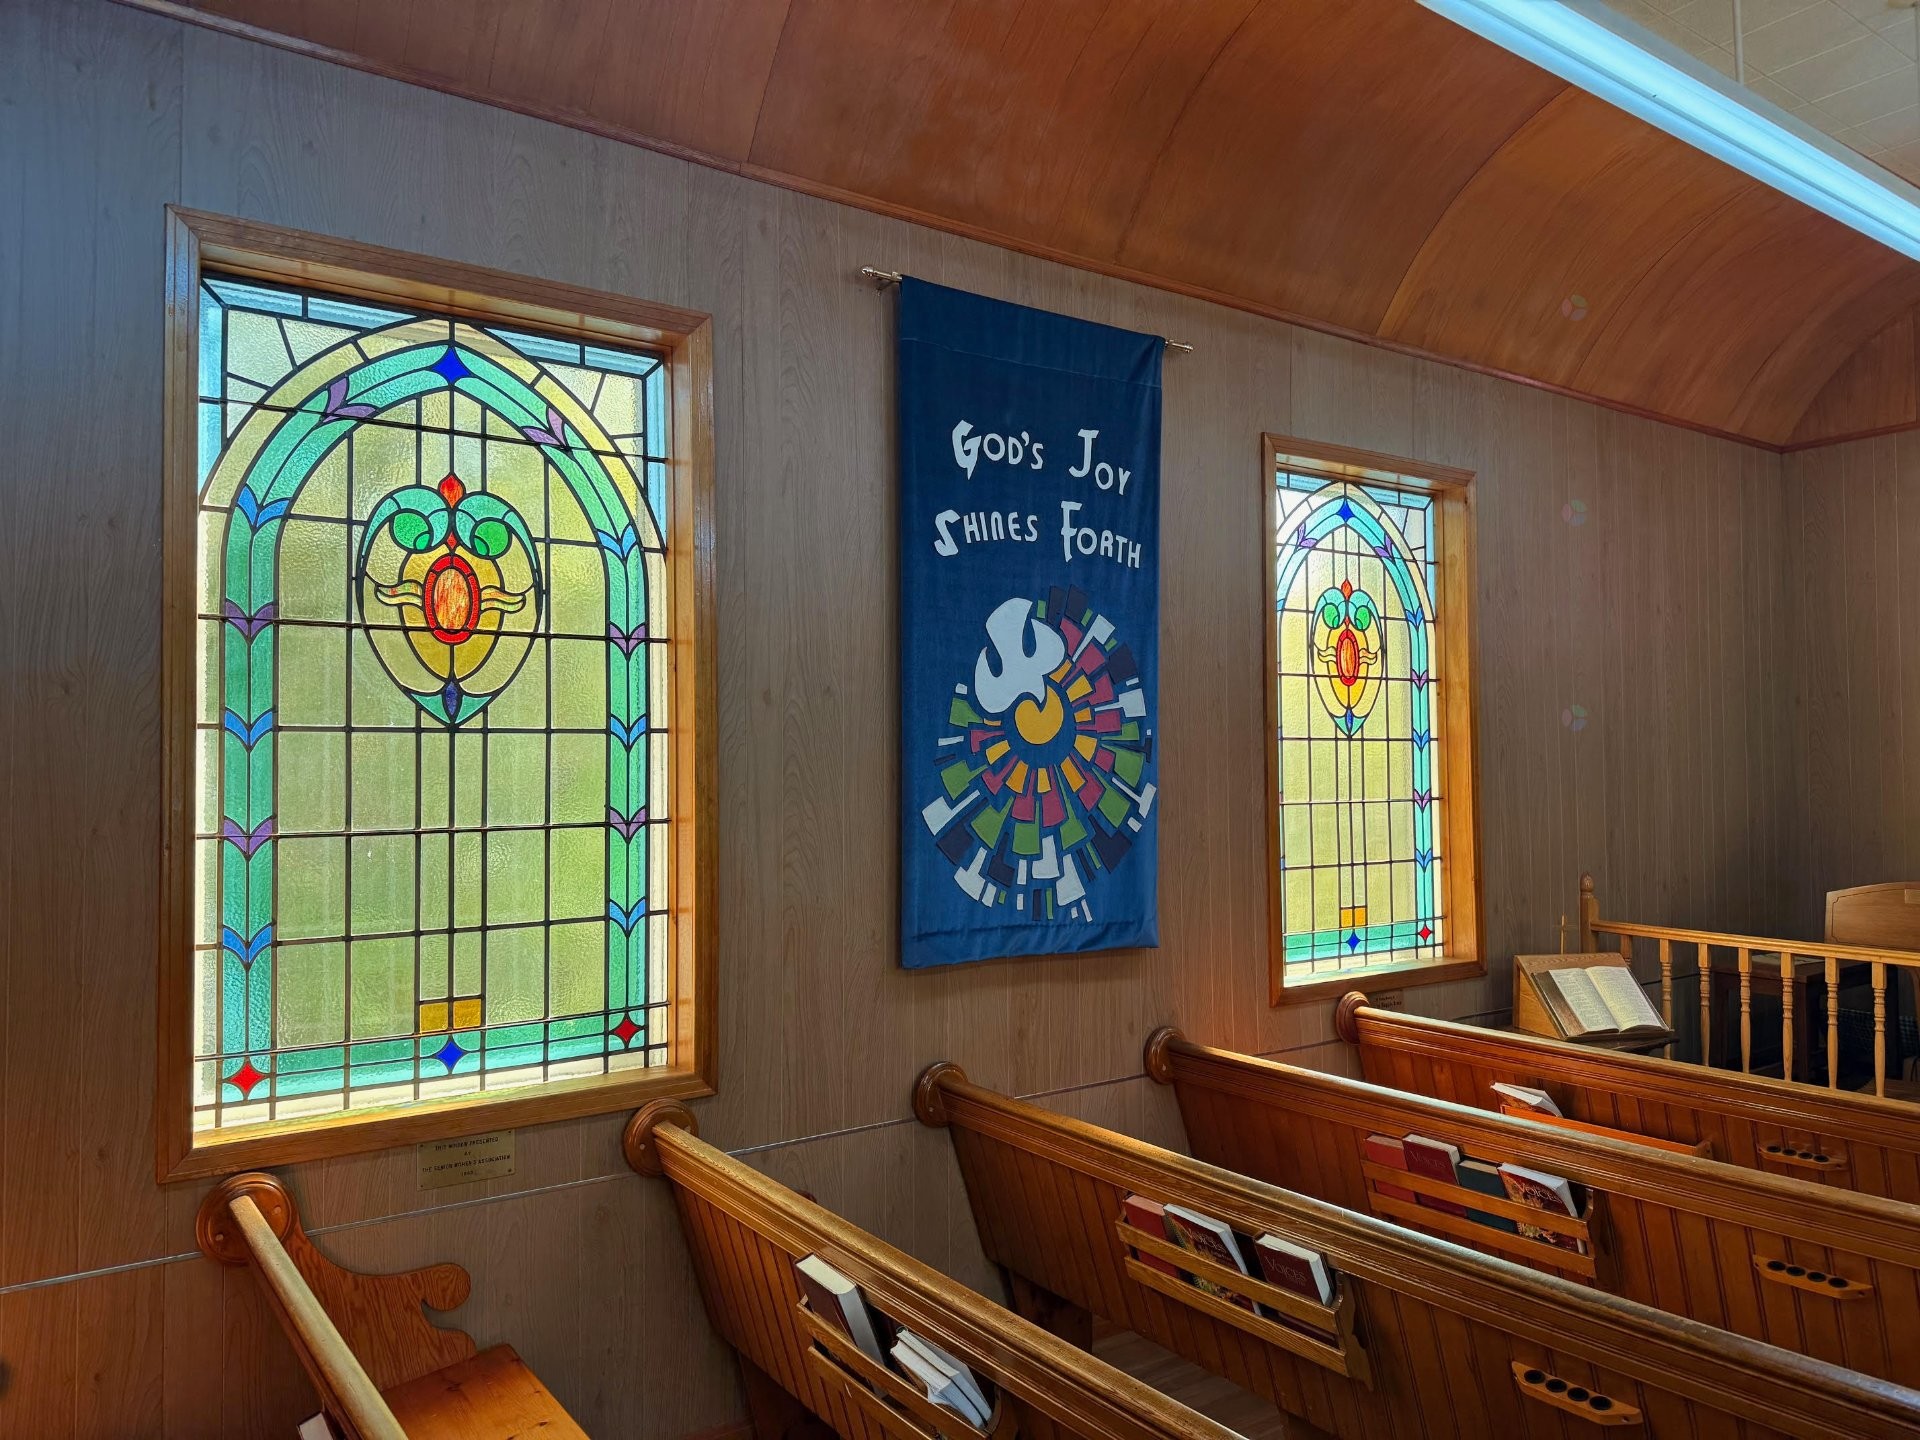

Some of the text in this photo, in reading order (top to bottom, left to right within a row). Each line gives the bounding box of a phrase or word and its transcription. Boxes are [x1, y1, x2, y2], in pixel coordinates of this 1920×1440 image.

[952, 420, 1131, 496] GOD'S JOY
[934, 500, 1142, 569] SHINES FORTH
